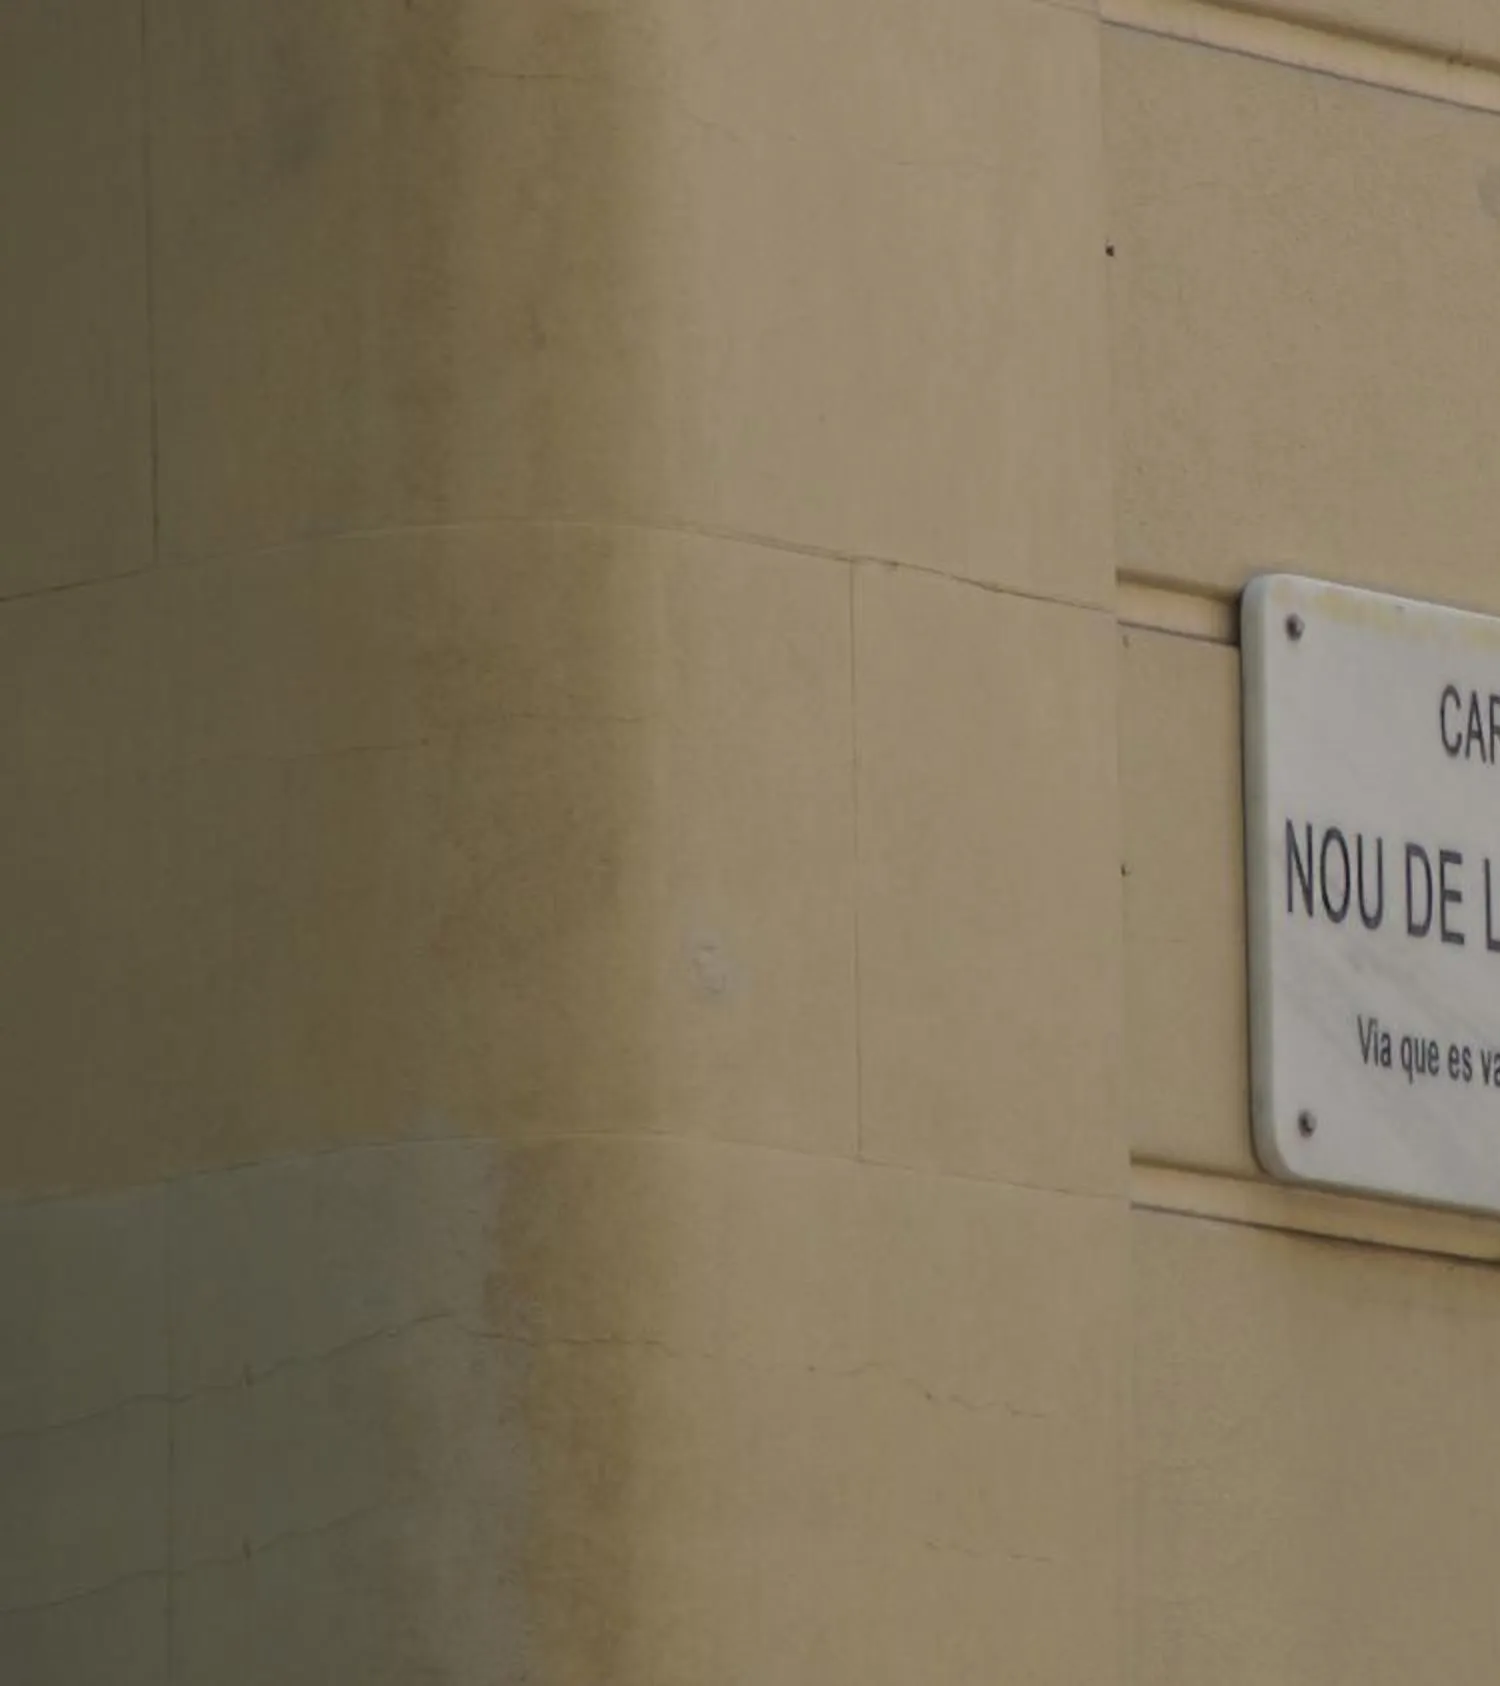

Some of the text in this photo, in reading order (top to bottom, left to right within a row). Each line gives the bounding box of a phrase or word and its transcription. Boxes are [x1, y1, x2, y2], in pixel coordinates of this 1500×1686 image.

[1285, 818, 1384, 930] NOU
[1404, 842, 1465, 946] DE
[1357, 1014, 1392, 1068] Via
[1400, 1035, 1440, 1085] que
[1447, 1044, 1473, 1083] es
